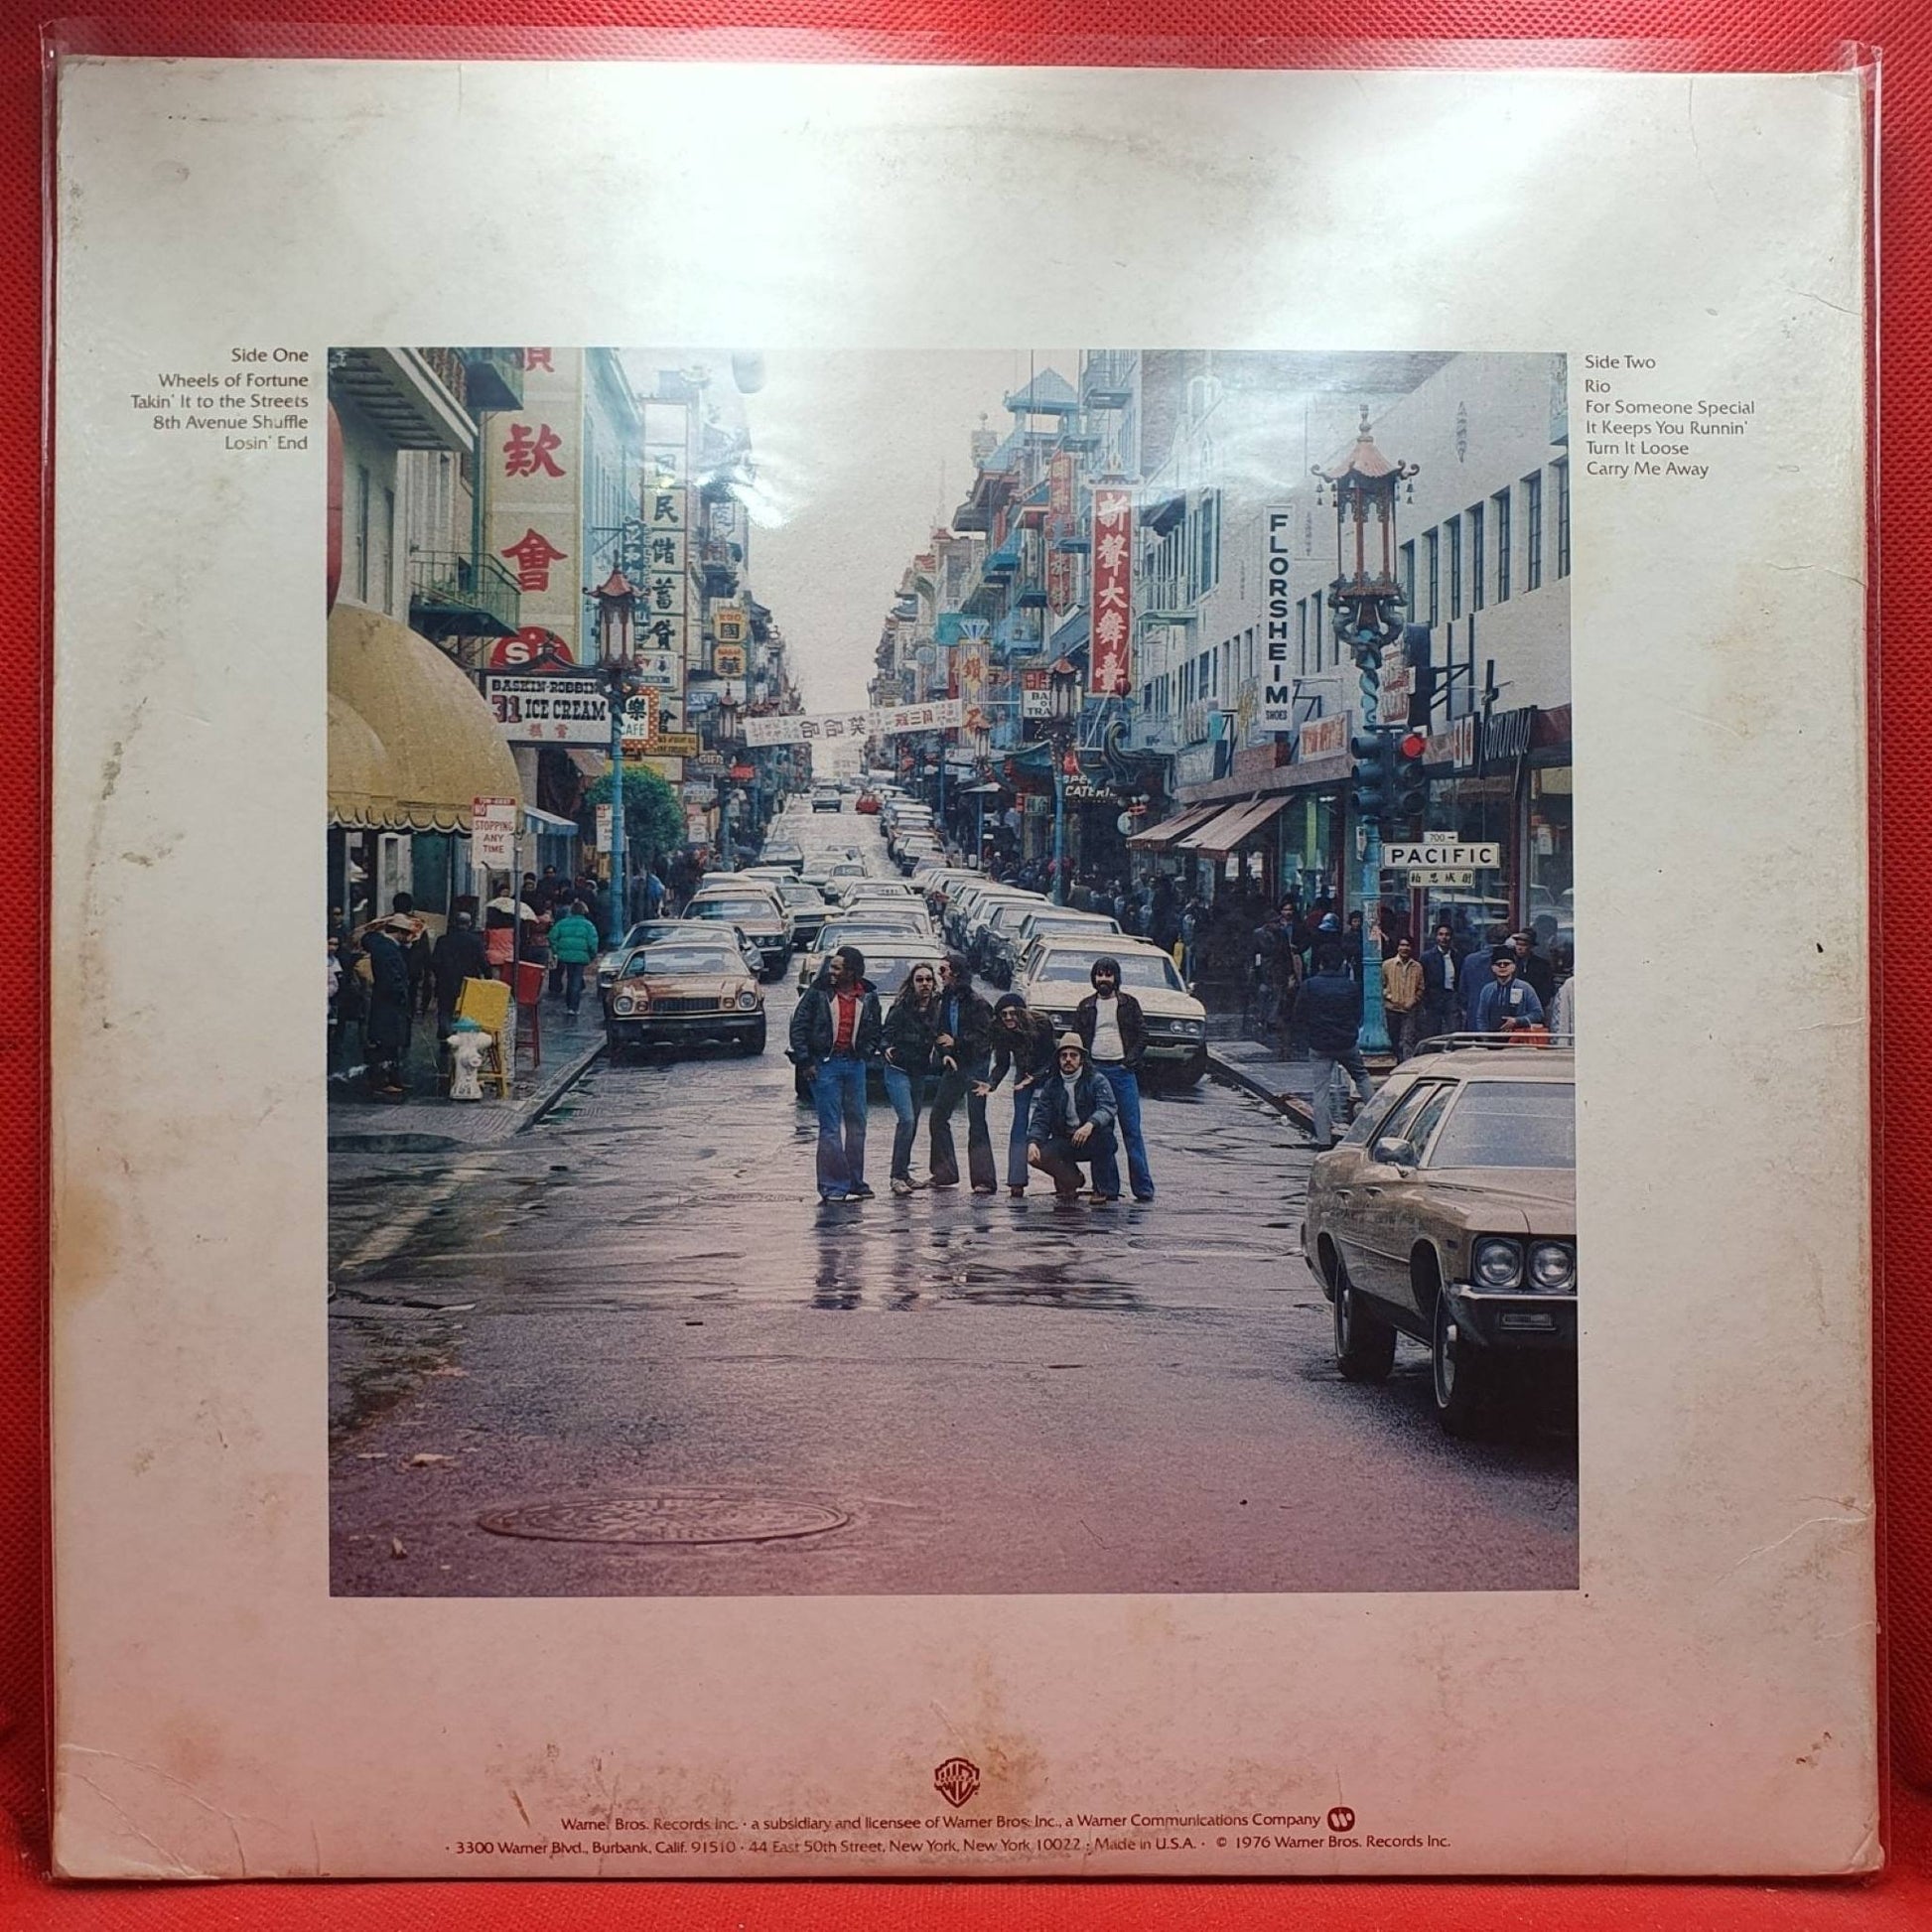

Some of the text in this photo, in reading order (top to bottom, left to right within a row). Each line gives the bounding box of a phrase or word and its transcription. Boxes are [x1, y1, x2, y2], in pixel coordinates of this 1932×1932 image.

[231, 347, 309, 362] Side One
[1585, 354, 1656, 369] Side Two
[158, 373, 309, 387] Wheels of Fortune
[1586, 379, 1610, 393] Rio
[130, 394, 309, 408] Takin' It to the Streets
[1586, 400, 1754, 417] For Someone Special
[153, 415, 308, 429] 8th Avenue Shuffle
[1587, 421, 1748, 437] It Keeps You Runnin'
[225, 436, 308, 450] Losin' End
[1587, 441, 1689, 456] Turn It Loose
[1587, 462, 1709, 479] Carry Me Away
[1266, 514, 1289, 704] FLORSHEIM
[491, 679, 597, 694] BASKIN-ROBBIN
[492, 695, 606, 723] 31 ICE CREAM
[1266, 709, 1288, 721] SHOES
[475, 820, 513, 831] STOPPING
[1391, 849, 1492, 863] PACIFIC
[615, 1818, 649, 1831] Bros.
[654, 1818, 711, 1831] Records
[715, 1818, 739, 1831] Inc.
[752, 1821, 760, 1831] a
[763, 1816, 832, 1833] subsidiary
[835, 1817, 861, 1830] and
[866, 1816, 921, 1830] licensee
[925, 1816, 942, 1830] of
[943, 1816, 993, 1830] Warner
[1035, 1815, 1062, 1829] Inc.,
[1065, 1817, 1073, 1827] a
[1077, 1814, 1127, 1827] Warner
[1131, 1813, 1248, 1827] Communications
[1252, 1813, 1321, 1829] Company
[456, 1842, 494, 1855] 3300
[498, 1842, 547, 1855] Warner
[592, 1842, 651, 1856] Burbank,
[655, 1841, 687, 1854] Calif.
[691, 1841, 736, 1854] 91510
[749, 1841, 767, 1854] 44
[772, 1840, 799, 1854] East
[804, 1840, 836, 1854] 50th
[890, 1840, 923, 1853] New
[964, 1839, 997, 1853] New
[1037, 1838, 1080, 1851] 10022
[1094, 1838, 1136, 1851] Made
[1140, 1837, 1152, 1850] in
[1156, 1837, 1196, 1850] U.S.A.
[1235, 1836, 1271, 1850] 1976
[1275, 1836, 1324, 1849] Warner
[1328, 1836, 1362, 1849] Bros.
[1366, 1835, 1424, 1848] Records
[1427, 1835, 1451, 1848] Inc.
